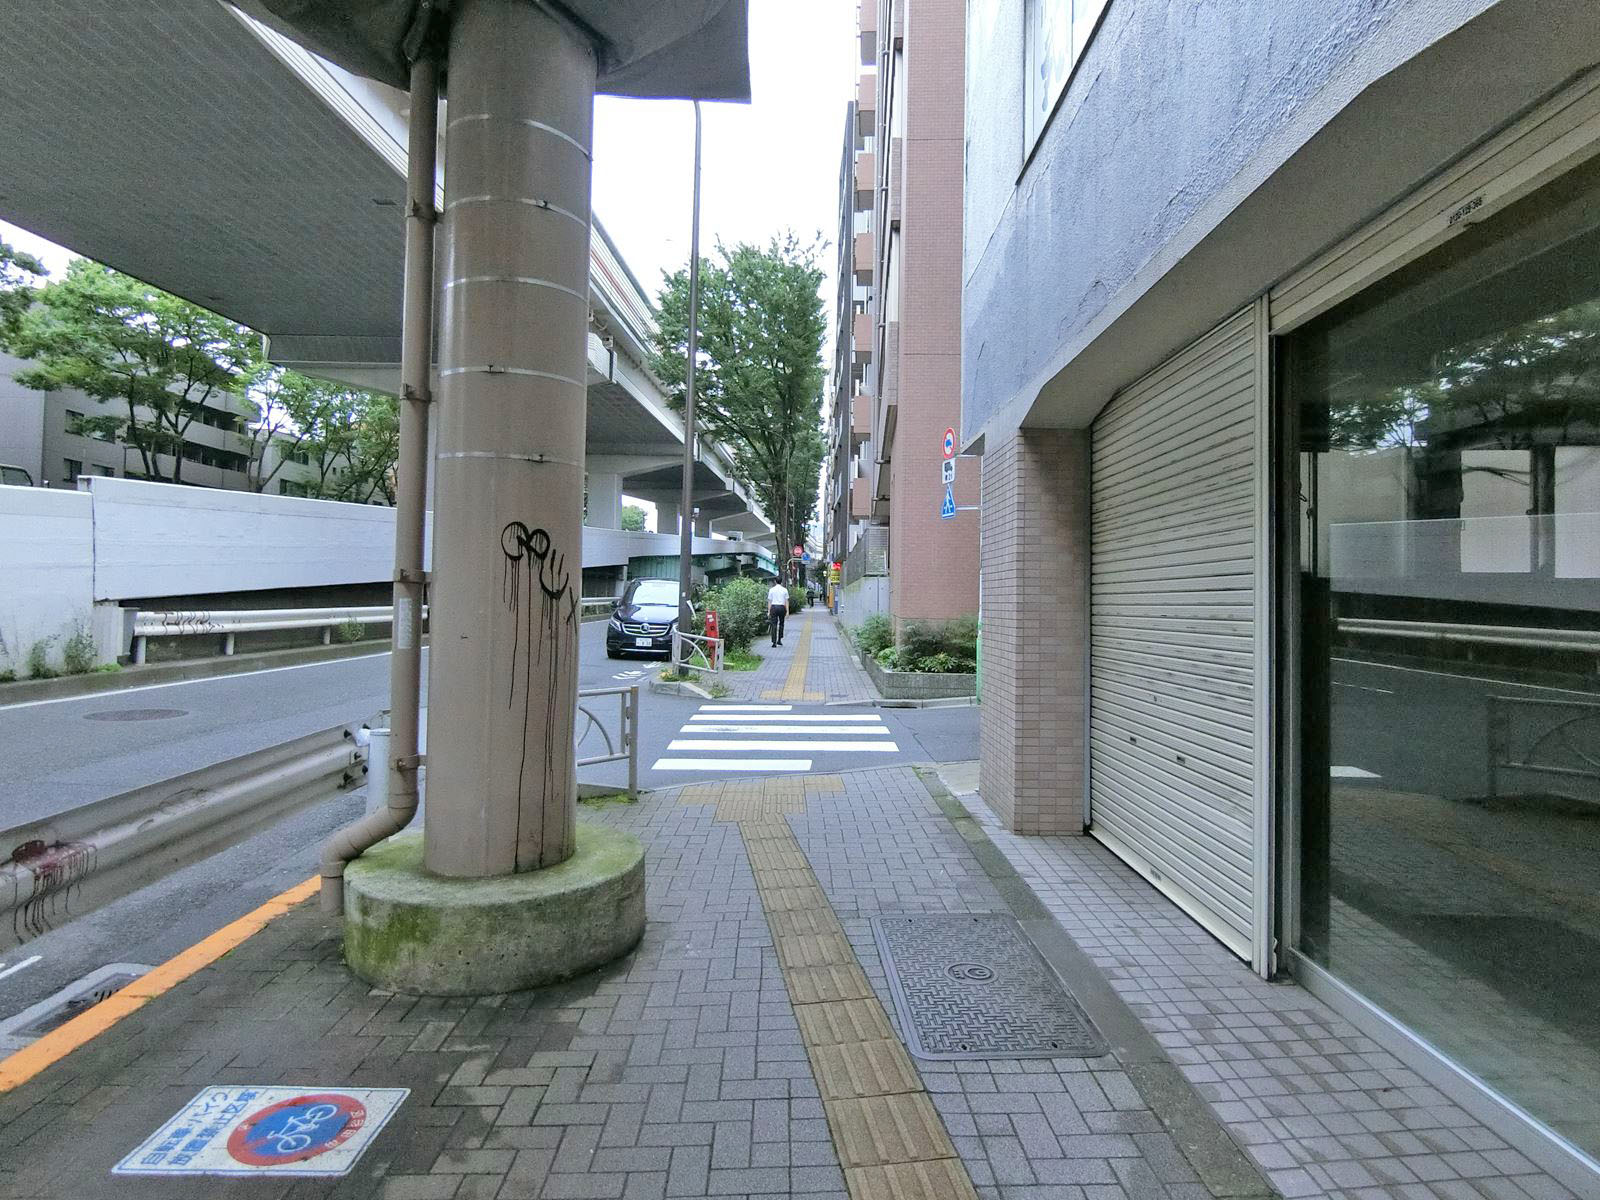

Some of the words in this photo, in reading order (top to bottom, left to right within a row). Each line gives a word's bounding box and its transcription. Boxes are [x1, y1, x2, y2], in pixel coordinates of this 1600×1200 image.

[140, 1091, 228, 1165] 自転車・バイク
[167, 1090, 258, 1166] 放置禁止区域
